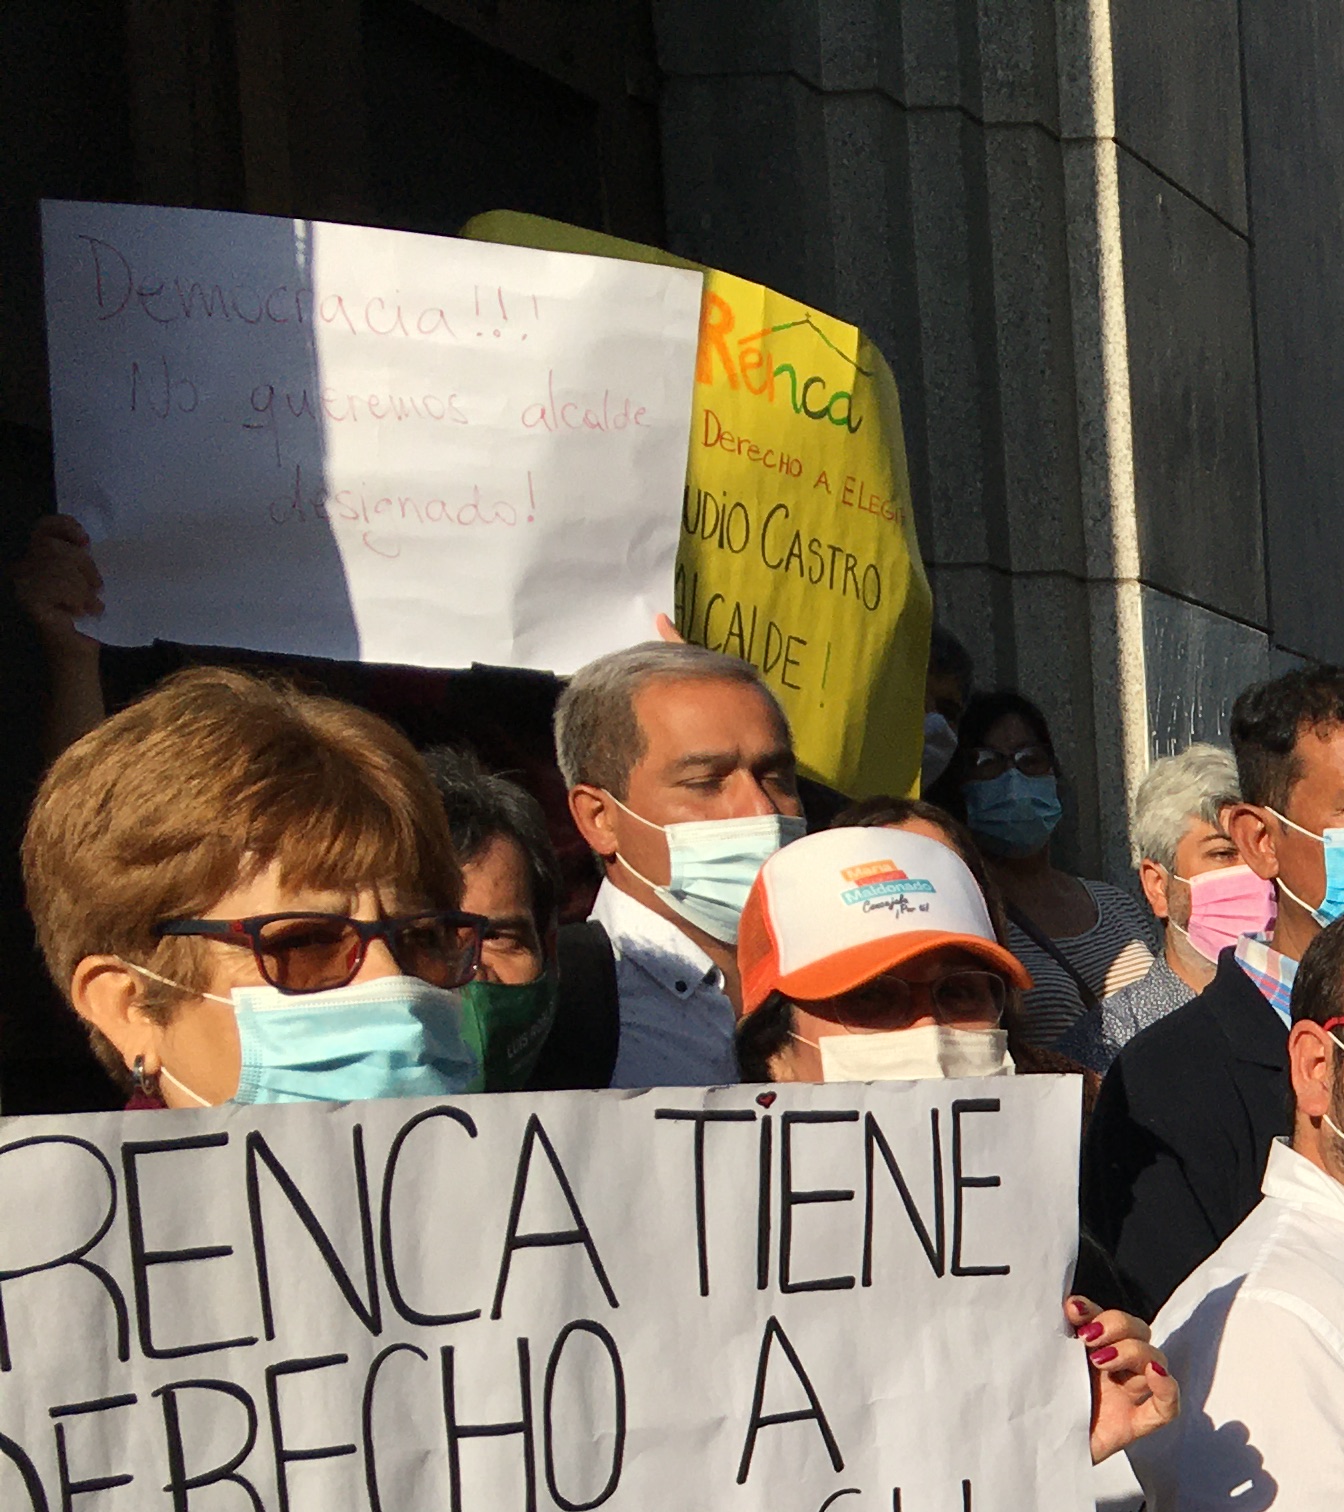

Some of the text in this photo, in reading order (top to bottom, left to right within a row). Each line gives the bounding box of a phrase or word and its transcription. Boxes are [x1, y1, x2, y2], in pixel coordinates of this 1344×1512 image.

[130, 354, 651, 468] No queremos alcalde
[696, 289, 864, 434] Renca
[268, 464, 536, 559] designado!
[813, 470, 832, 495] A
[760, 502, 882, 612] CASTRO
[844, 880, 934, 904] Maldonado
[0, 1104, 620, 1372] RENCA
[736, 1314, 845, 1486] A
